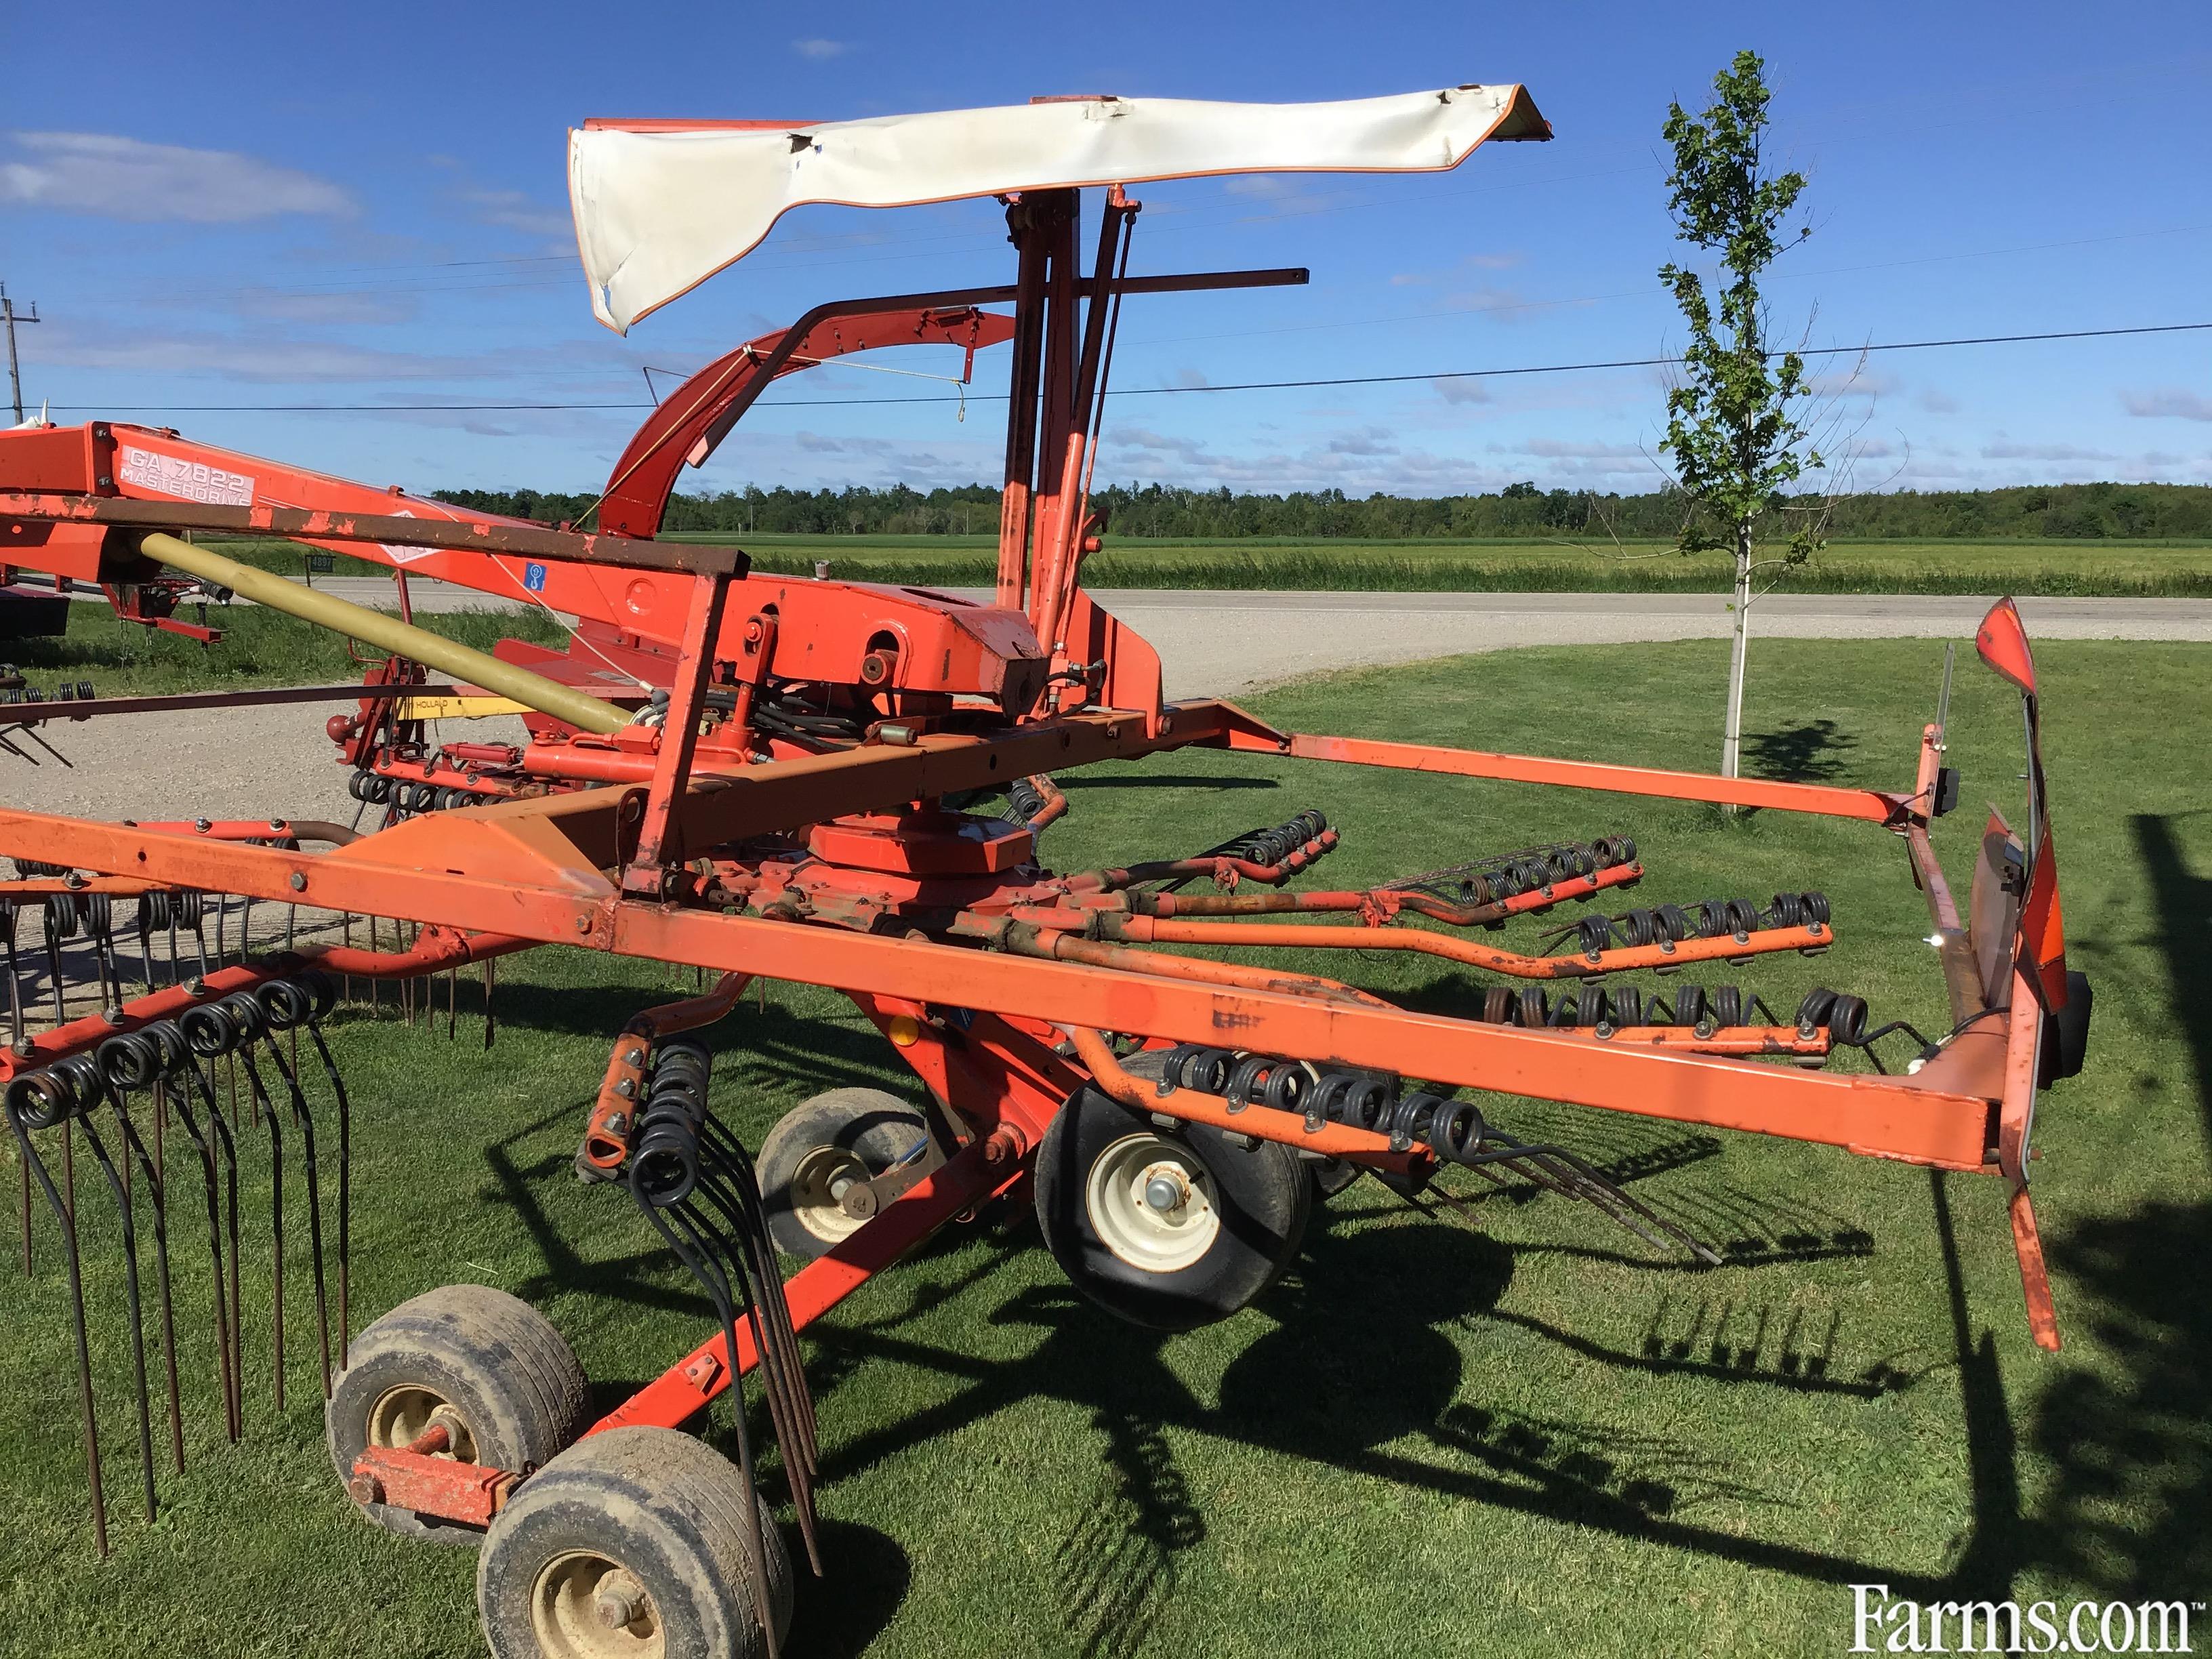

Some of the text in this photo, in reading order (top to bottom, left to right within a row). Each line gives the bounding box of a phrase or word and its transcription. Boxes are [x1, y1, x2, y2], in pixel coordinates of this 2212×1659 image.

[129, 449, 245, 493] GA 7822
[312, 556, 331, 567] 4897
